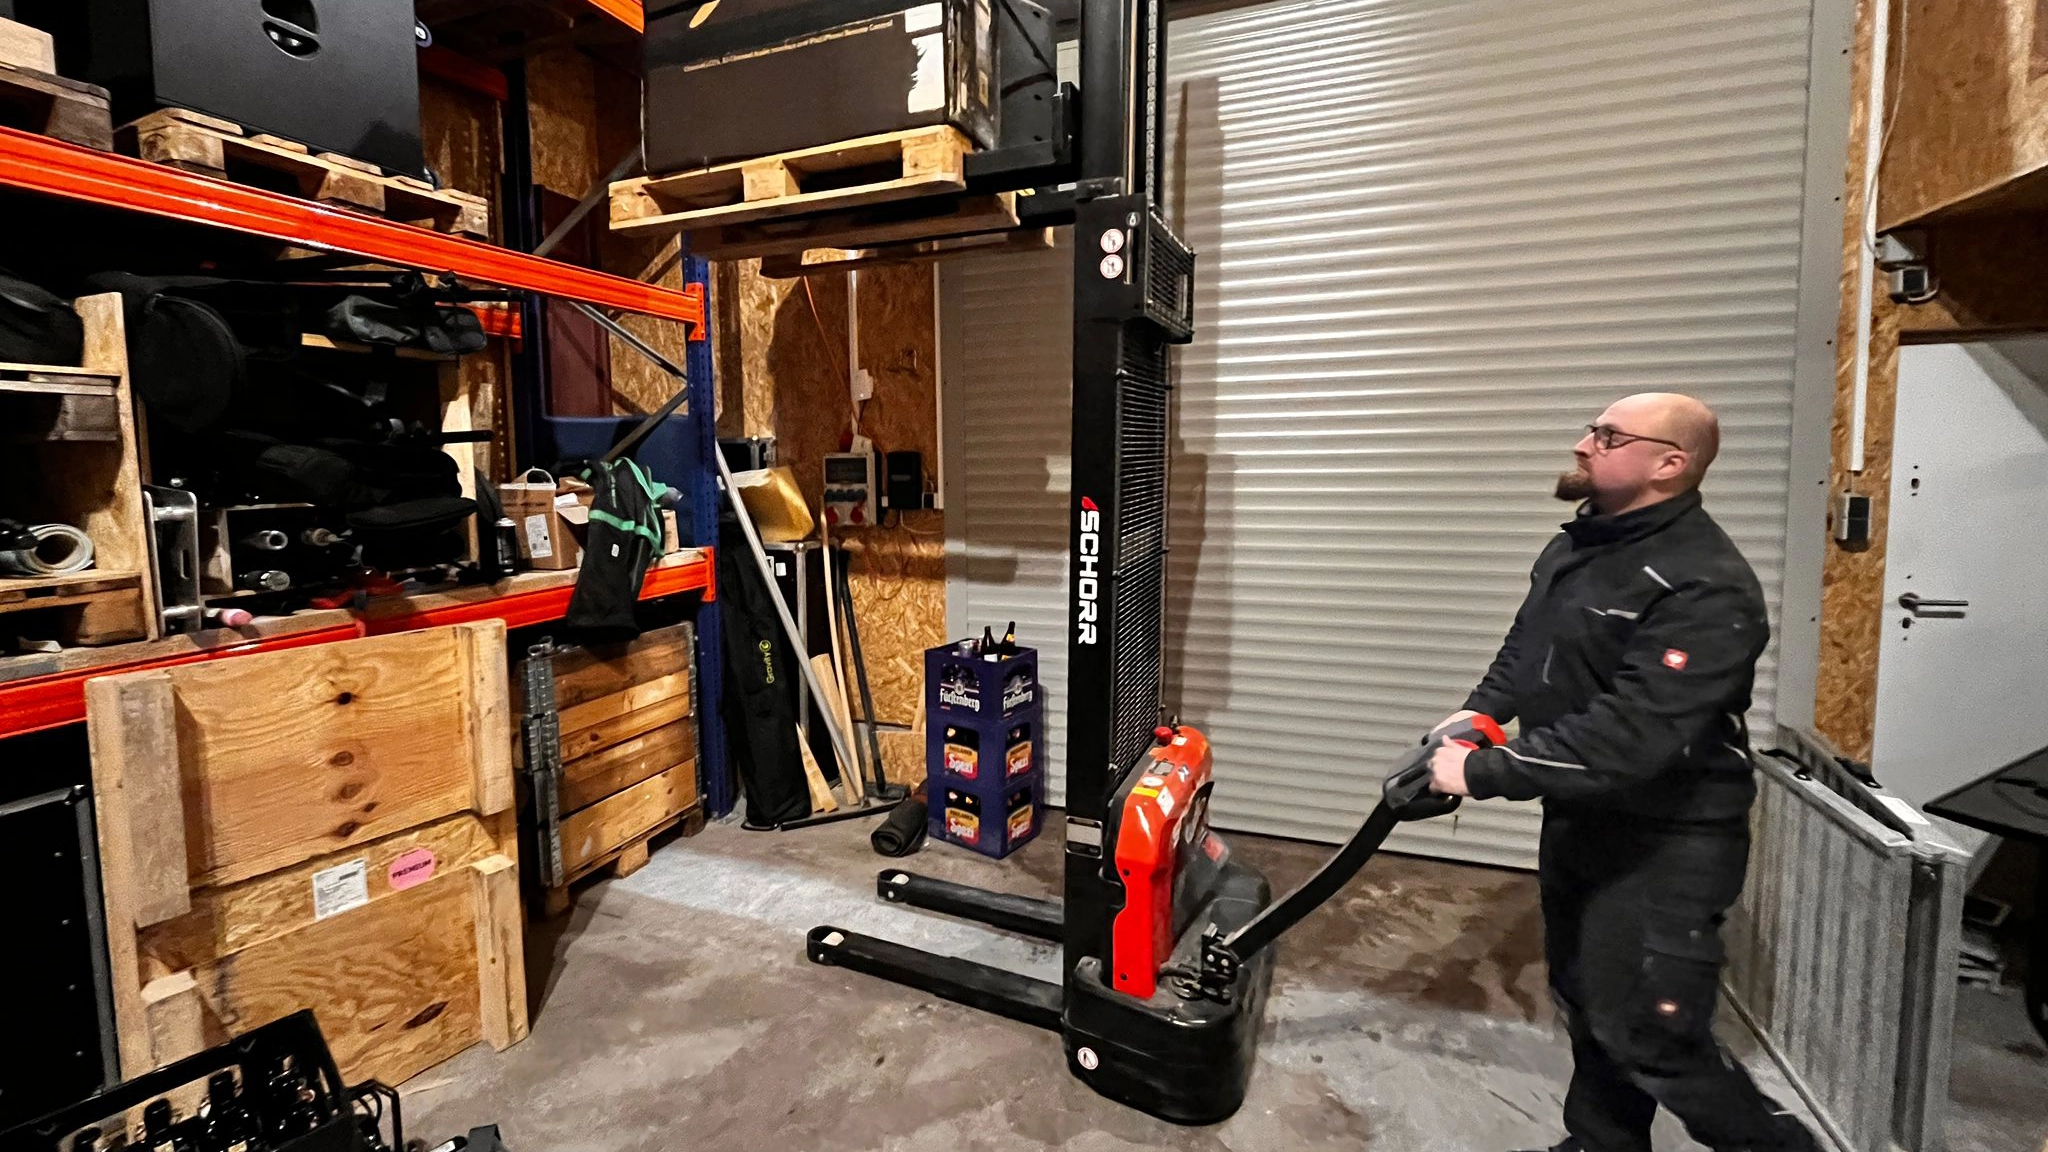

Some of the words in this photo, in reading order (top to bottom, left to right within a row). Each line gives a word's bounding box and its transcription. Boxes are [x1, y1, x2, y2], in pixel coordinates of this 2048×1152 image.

[1078, 510, 1100, 645] SCHORR
[763, 652, 775, 684] Gravity
[948, 753, 973, 774] Spezi
[950, 817, 975, 838] Spezi
[392, 859, 432, 879] PREMIUM
